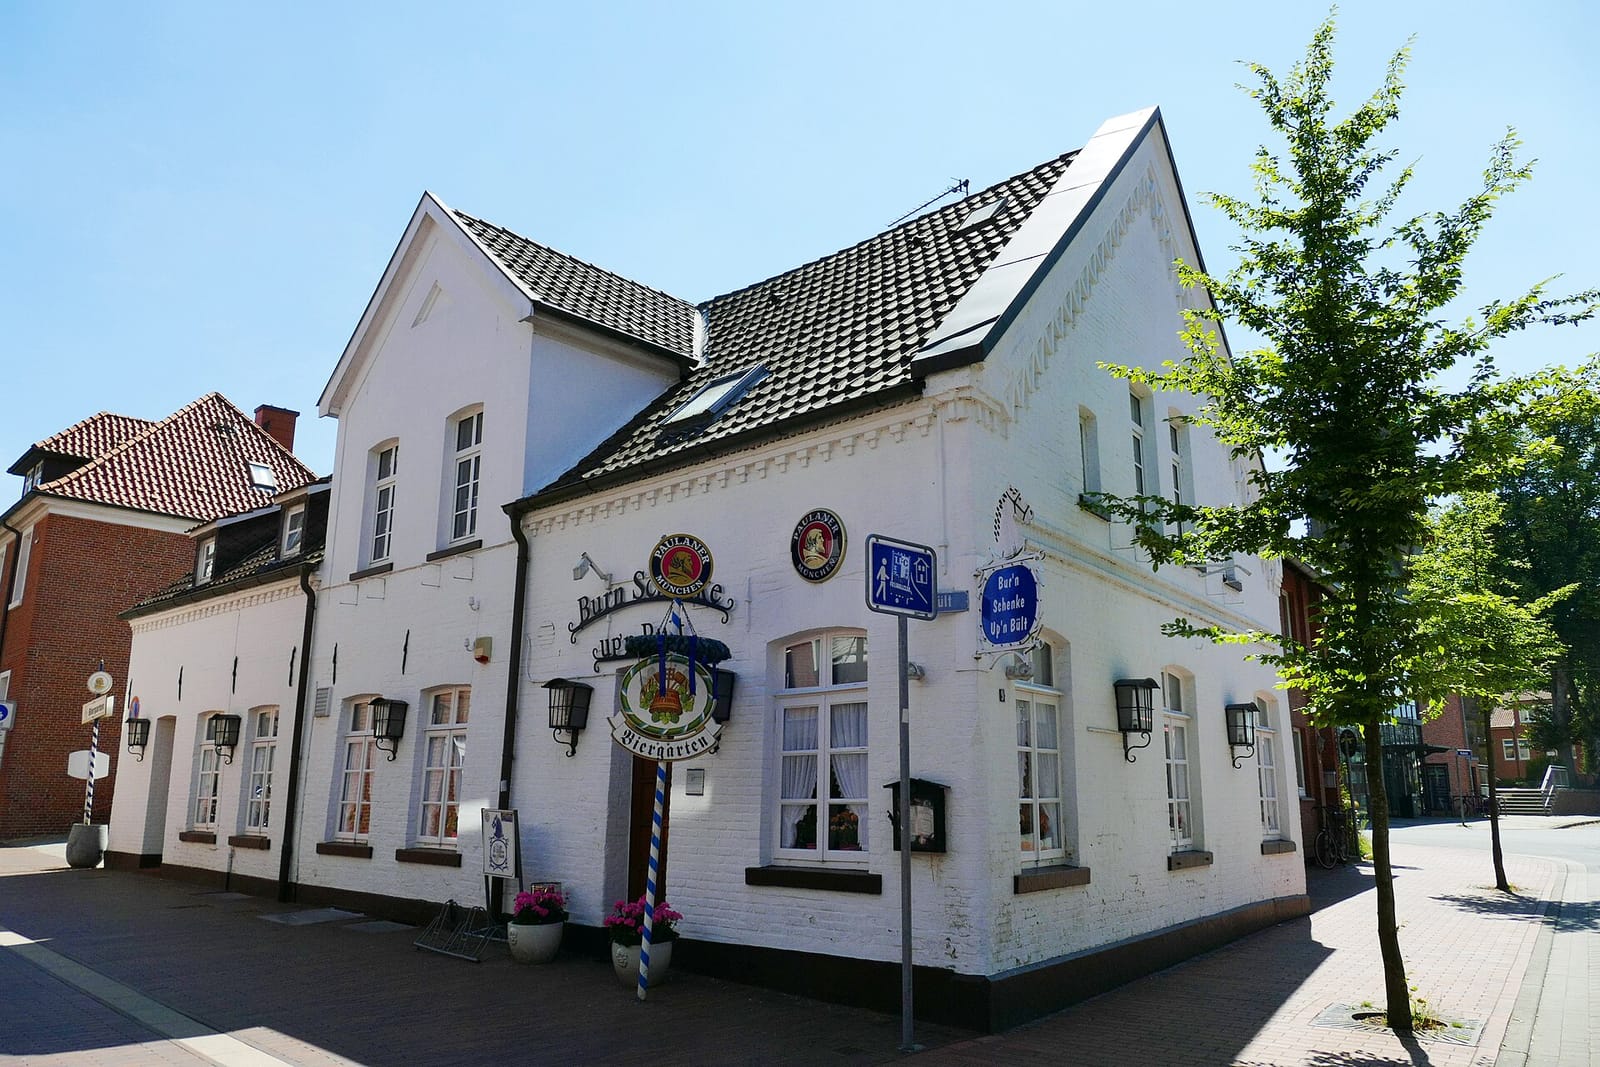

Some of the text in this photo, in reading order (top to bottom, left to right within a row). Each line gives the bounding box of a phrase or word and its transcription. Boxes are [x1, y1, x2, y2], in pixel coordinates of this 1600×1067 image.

[794, 512, 839, 540] PAULANER
[655, 538, 710, 565] PAULANER
[998, 573, 1020, 591] Bur'n
[937, 594, 952, 608] ült
[993, 594, 1025, 613] Schenke
[990, 616, 1028, 639] Up'n Bült
